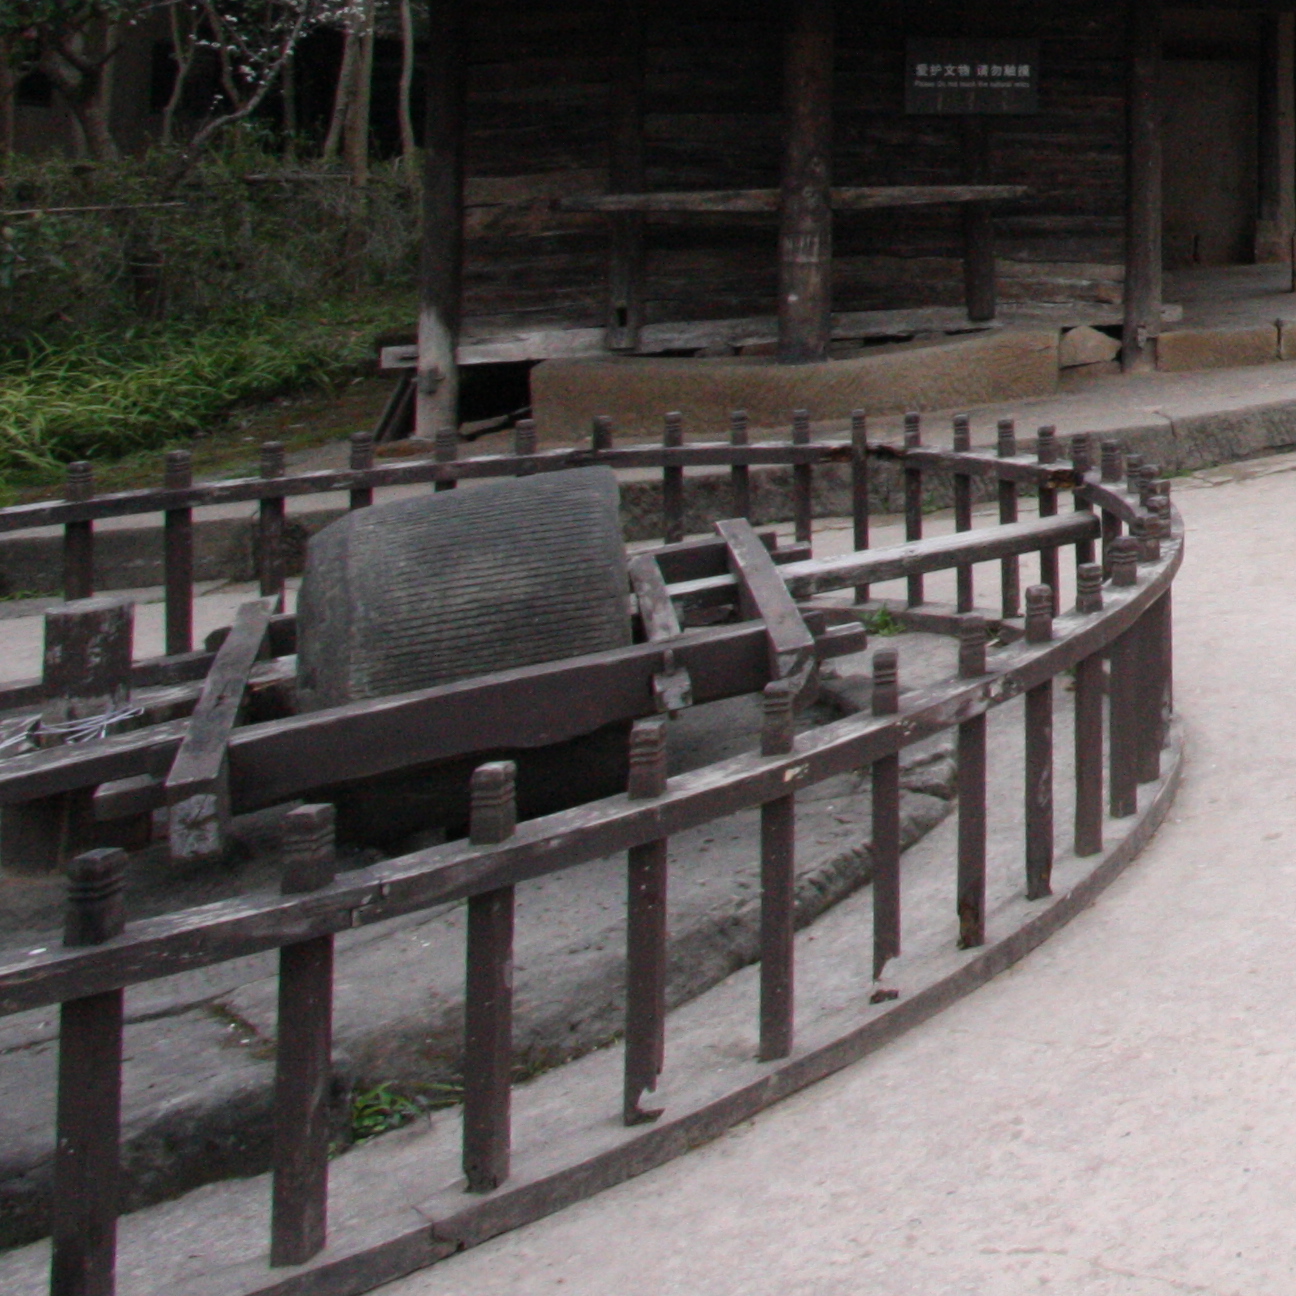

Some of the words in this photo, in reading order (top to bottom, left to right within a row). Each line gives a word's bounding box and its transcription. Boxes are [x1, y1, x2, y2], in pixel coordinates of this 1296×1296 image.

[915, 63, 970, 77] 爱护文物
[976, 64, 1030, 77] 请勿触摸
